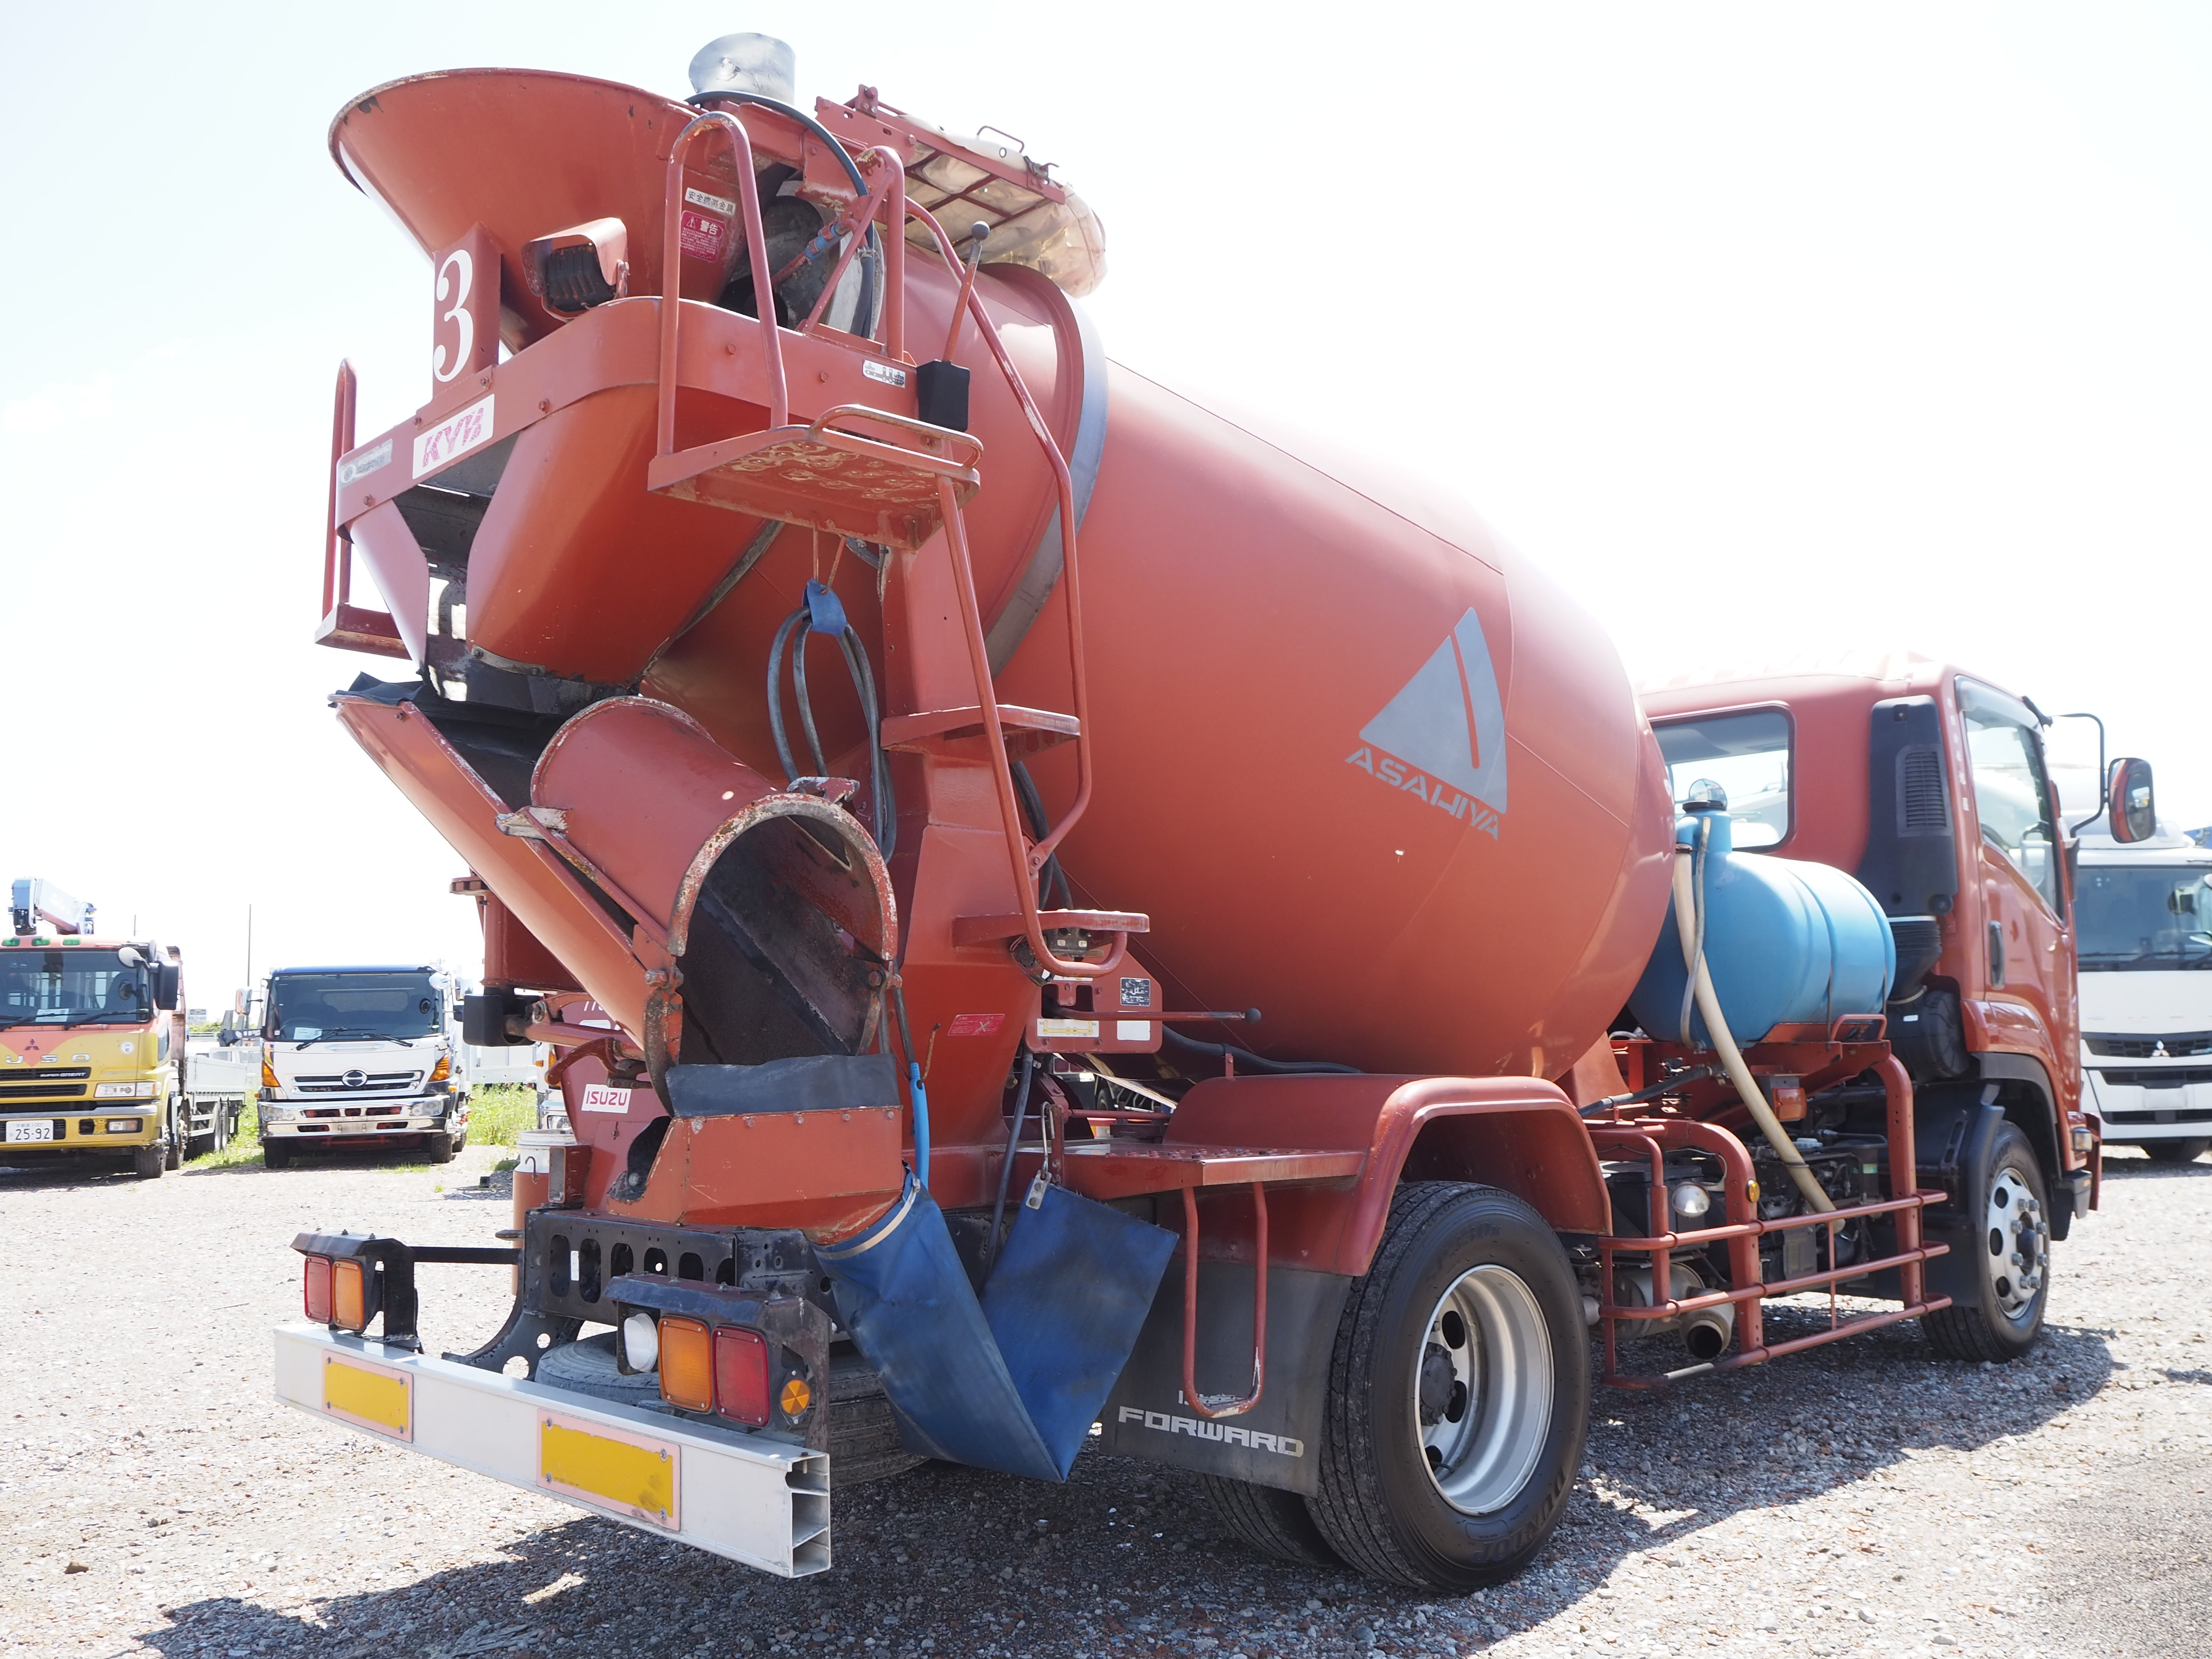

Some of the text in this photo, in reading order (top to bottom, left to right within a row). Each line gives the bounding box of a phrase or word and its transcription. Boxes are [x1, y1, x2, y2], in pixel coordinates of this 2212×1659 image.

[700, 219, 718, 235] 警告
[433, 249, 473, 382] 3
[422, 407, 484, 467] KYB
[1344, 746, 1499, 840] ASAHIYA
[586, 1091, 627, 1106] ISUZU
[15, 1128, 50, 1140] 25-92
[1118, 1406, 1304, 1457] FORWARD
[1470, 1467, 1566, 1563] DUNLOP
